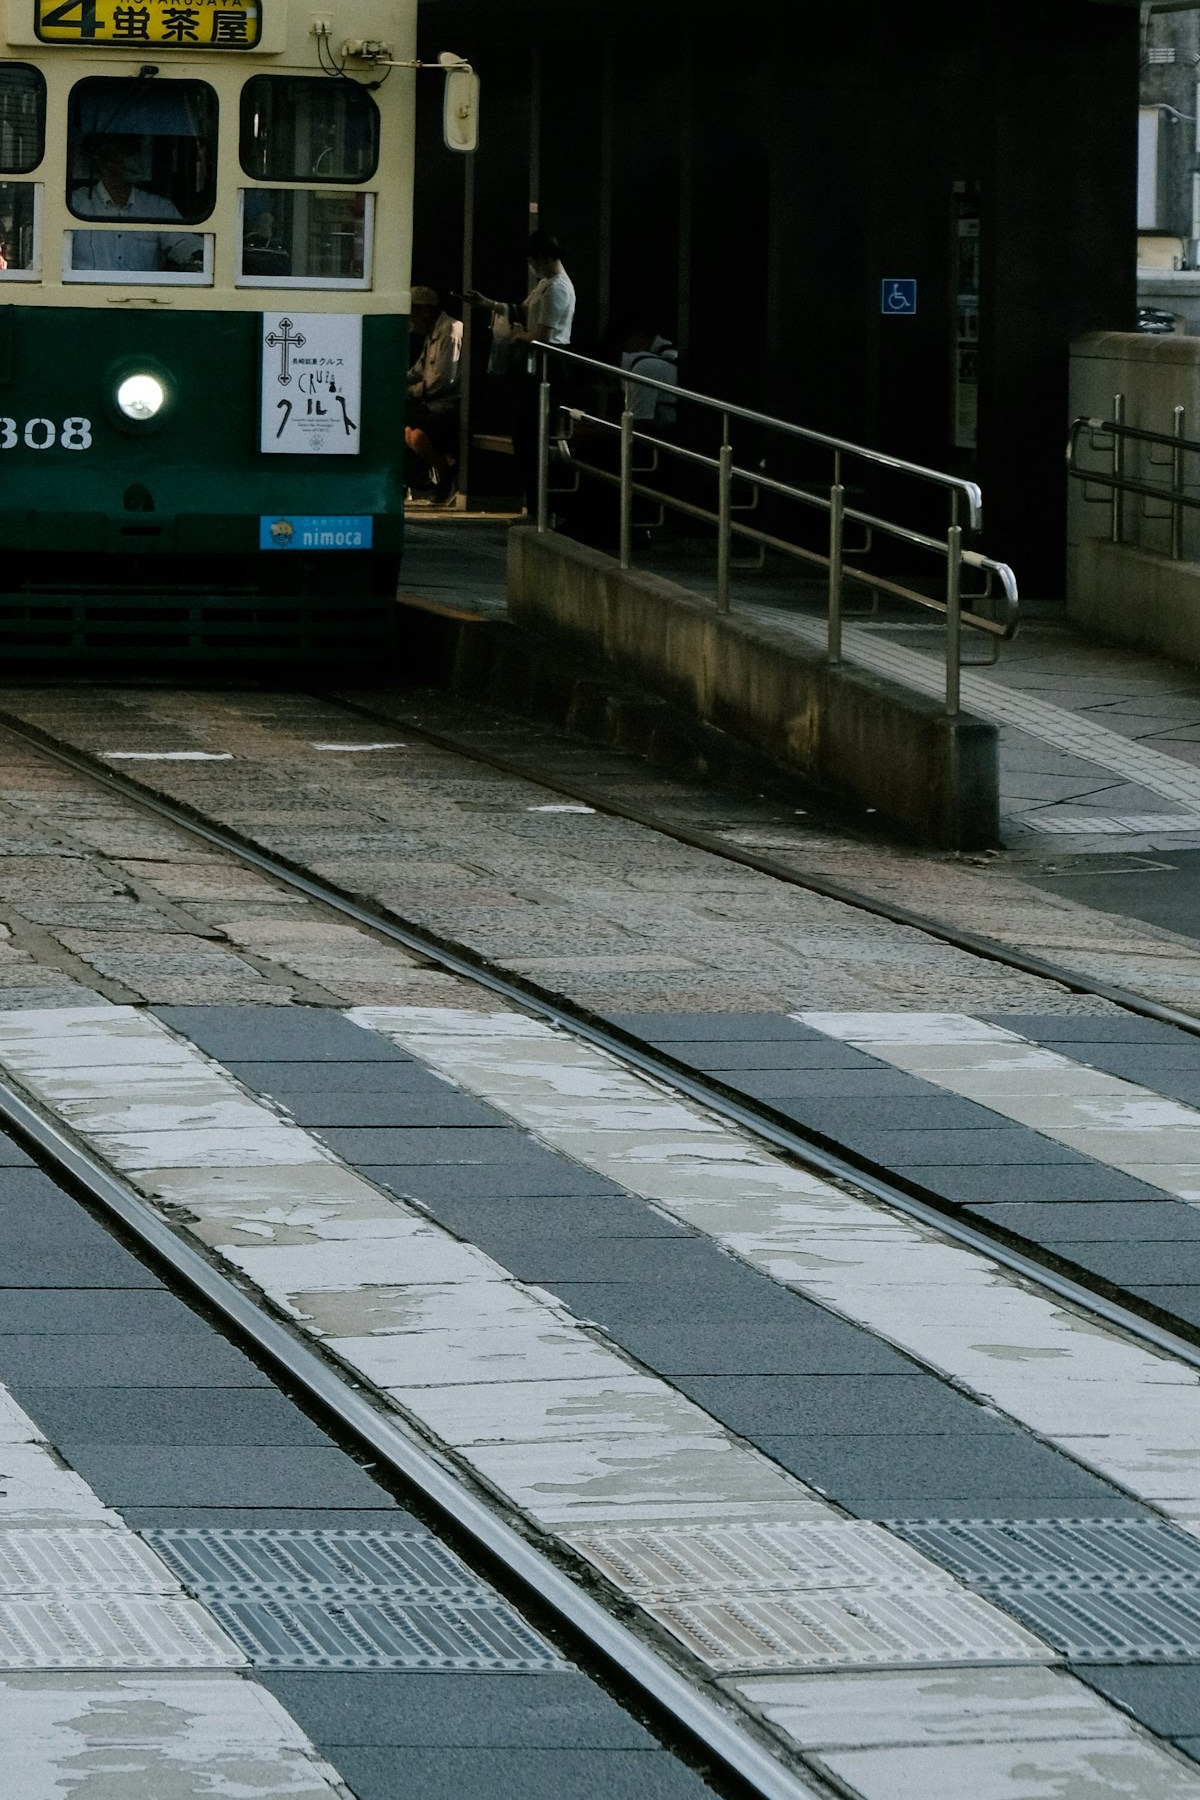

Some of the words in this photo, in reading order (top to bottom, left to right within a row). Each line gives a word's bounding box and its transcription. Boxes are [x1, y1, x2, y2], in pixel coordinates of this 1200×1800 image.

[112, 5, 249, 43] 蛍茶屋
[303, 527, 362, 546] nimoca
